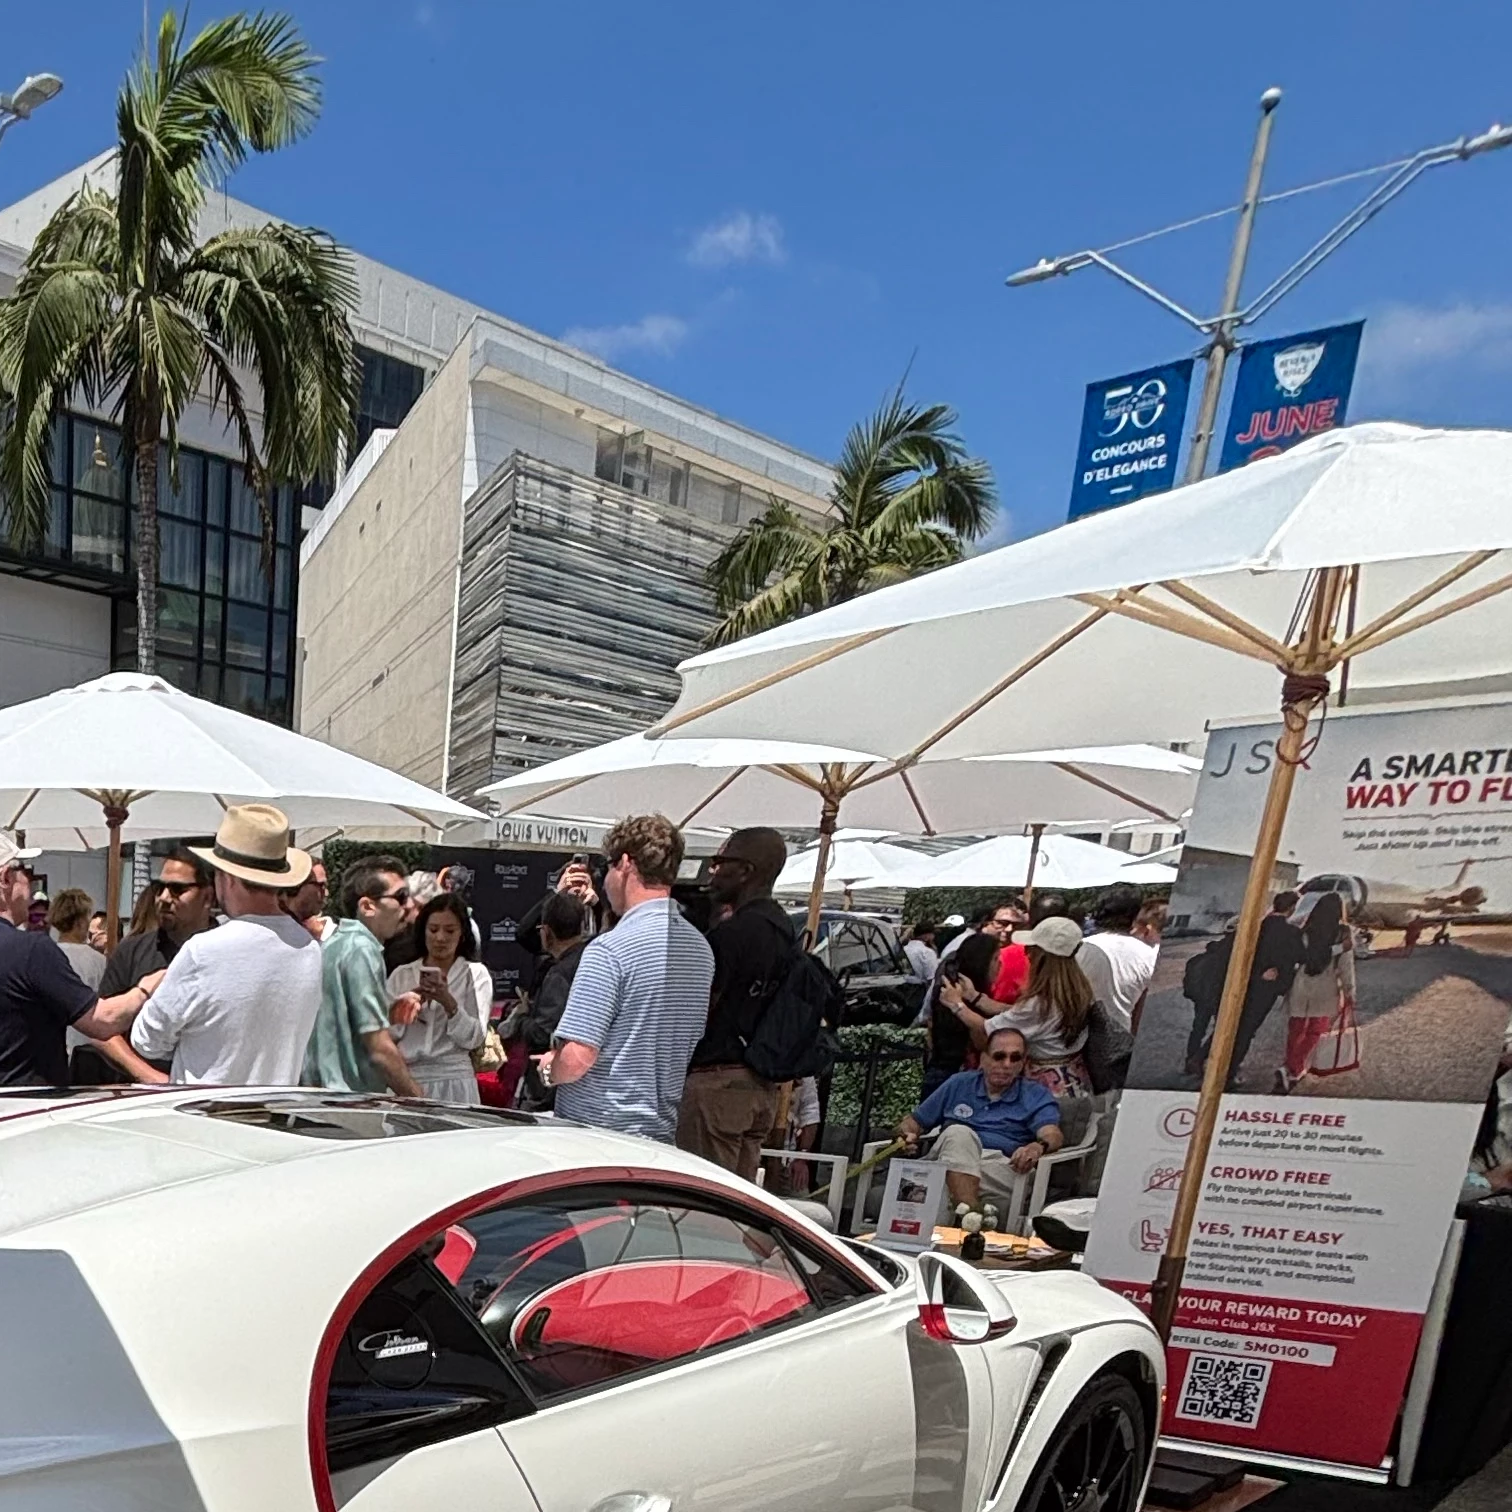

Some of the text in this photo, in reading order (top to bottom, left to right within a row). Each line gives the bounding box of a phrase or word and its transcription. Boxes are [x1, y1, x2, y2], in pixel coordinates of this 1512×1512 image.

[1236, 398, 1339, 444] JUNE
[1091, 433, 1166, 462] CONCOURS
[1082, 453, 1168, 485] D'ELEGANCE
[1350, 758, 1372, 782] A
[1346, 777, 1512, 809] WAY TO FL
[496, 821, 589, 844] LOUIS VUITTON
[1224, 1110, 1348, 1128] HASSLE FREE
[1251, 1128, 1272, 1138] just
[1273, 1129, 1288, 1140] 20
[1290, 1130, 1302, 1138] to
[1320, 1133, 1364, 1142] minutes
[1218, 1138, 1250, 1148] before
[1251, 1141, 1301, 1152] departure
[1303, 1143, 1317, 1151] on
[1319, 1144, 1346, 1153] most
[1210, 1166, 1332, 1186] CROWD FREE
[1207, 1182, 1352, 1201] Fly through private terminals
[1241, 1198, 1285, 1208] crowded
[1287, 1200, 1322, 1212] airport
[1197, 1222, 1344, 1246] YES, THAT EASY
[1221, 1241, 1230, 1249] in
[1232, 1243, 1274, 1254] spacious
[1276, 1246, 1312, 1256] leather
[1315, 1250, 1343, 1260] seats
[1208, 1262, 1245, 1274] Starlink
[1274, 1269, 1292, 1279] and
[1176, 1295, 1222, 1313] YOUR
[1225, 1301, 1300, 1322] REWARD
[1306, 1309, 1368, 1329] TODAY
[1192, 1316, 1277, 1333] Join Club JSX
[1172, 1334, 1200, 1345] erral
